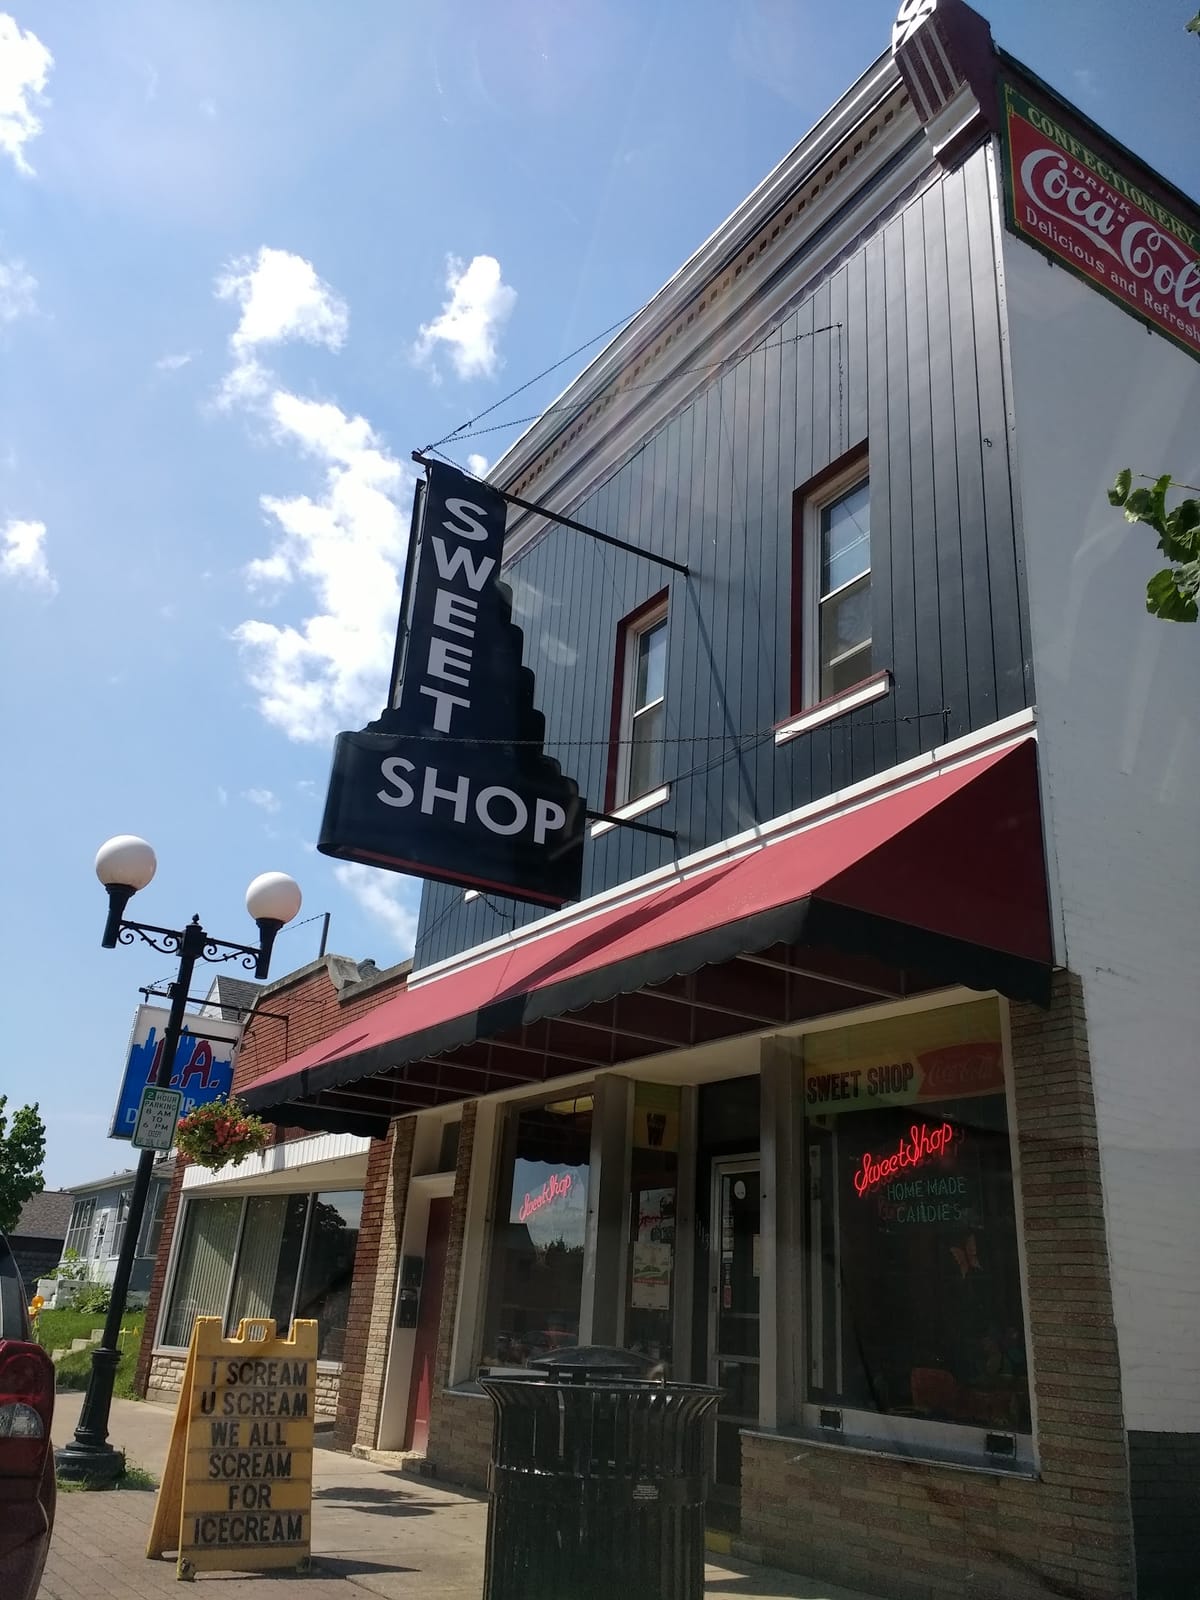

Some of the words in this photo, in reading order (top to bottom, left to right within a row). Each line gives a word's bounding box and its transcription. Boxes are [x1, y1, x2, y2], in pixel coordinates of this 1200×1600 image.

[1028, 107, 1195, 246] CONFECTIONERY
[1072, 166, 1132, 215] DRINK
[1026, 206, 1105, 275] Delicious
[1111, 270, 1137, 298] and
[420, 498, 496, 734] SWEET
[377, 757, 566, 844] SHOP
[807, 1070, 862, 1104] SWEET
[867, 1063, 914, 1096] SHOP
[145, 1101, 177, 1111] PARKING
[156, 1094, 177, 1104] HOUR
[154, 1123, 169, 1131] PM
[888, 1180, 923, 1200] HOME
[927, 1176, 968, 1196] MADE
[210, 1361, 217, 1385] I
[226, 1362, 308, 1386] SCREAM
[201, 1392, 216, 1415] U
[223, 1392, 308, 1416] SCREAM
[211, 1422, 240, 1446] WE
[249, 1423, 287, 1446] ALL
[209, 1452, 292, 1478] SCREAM
[228, 1484, 272, 1509] FOR
[194, 1515, 303, 1544] ICECREAM
